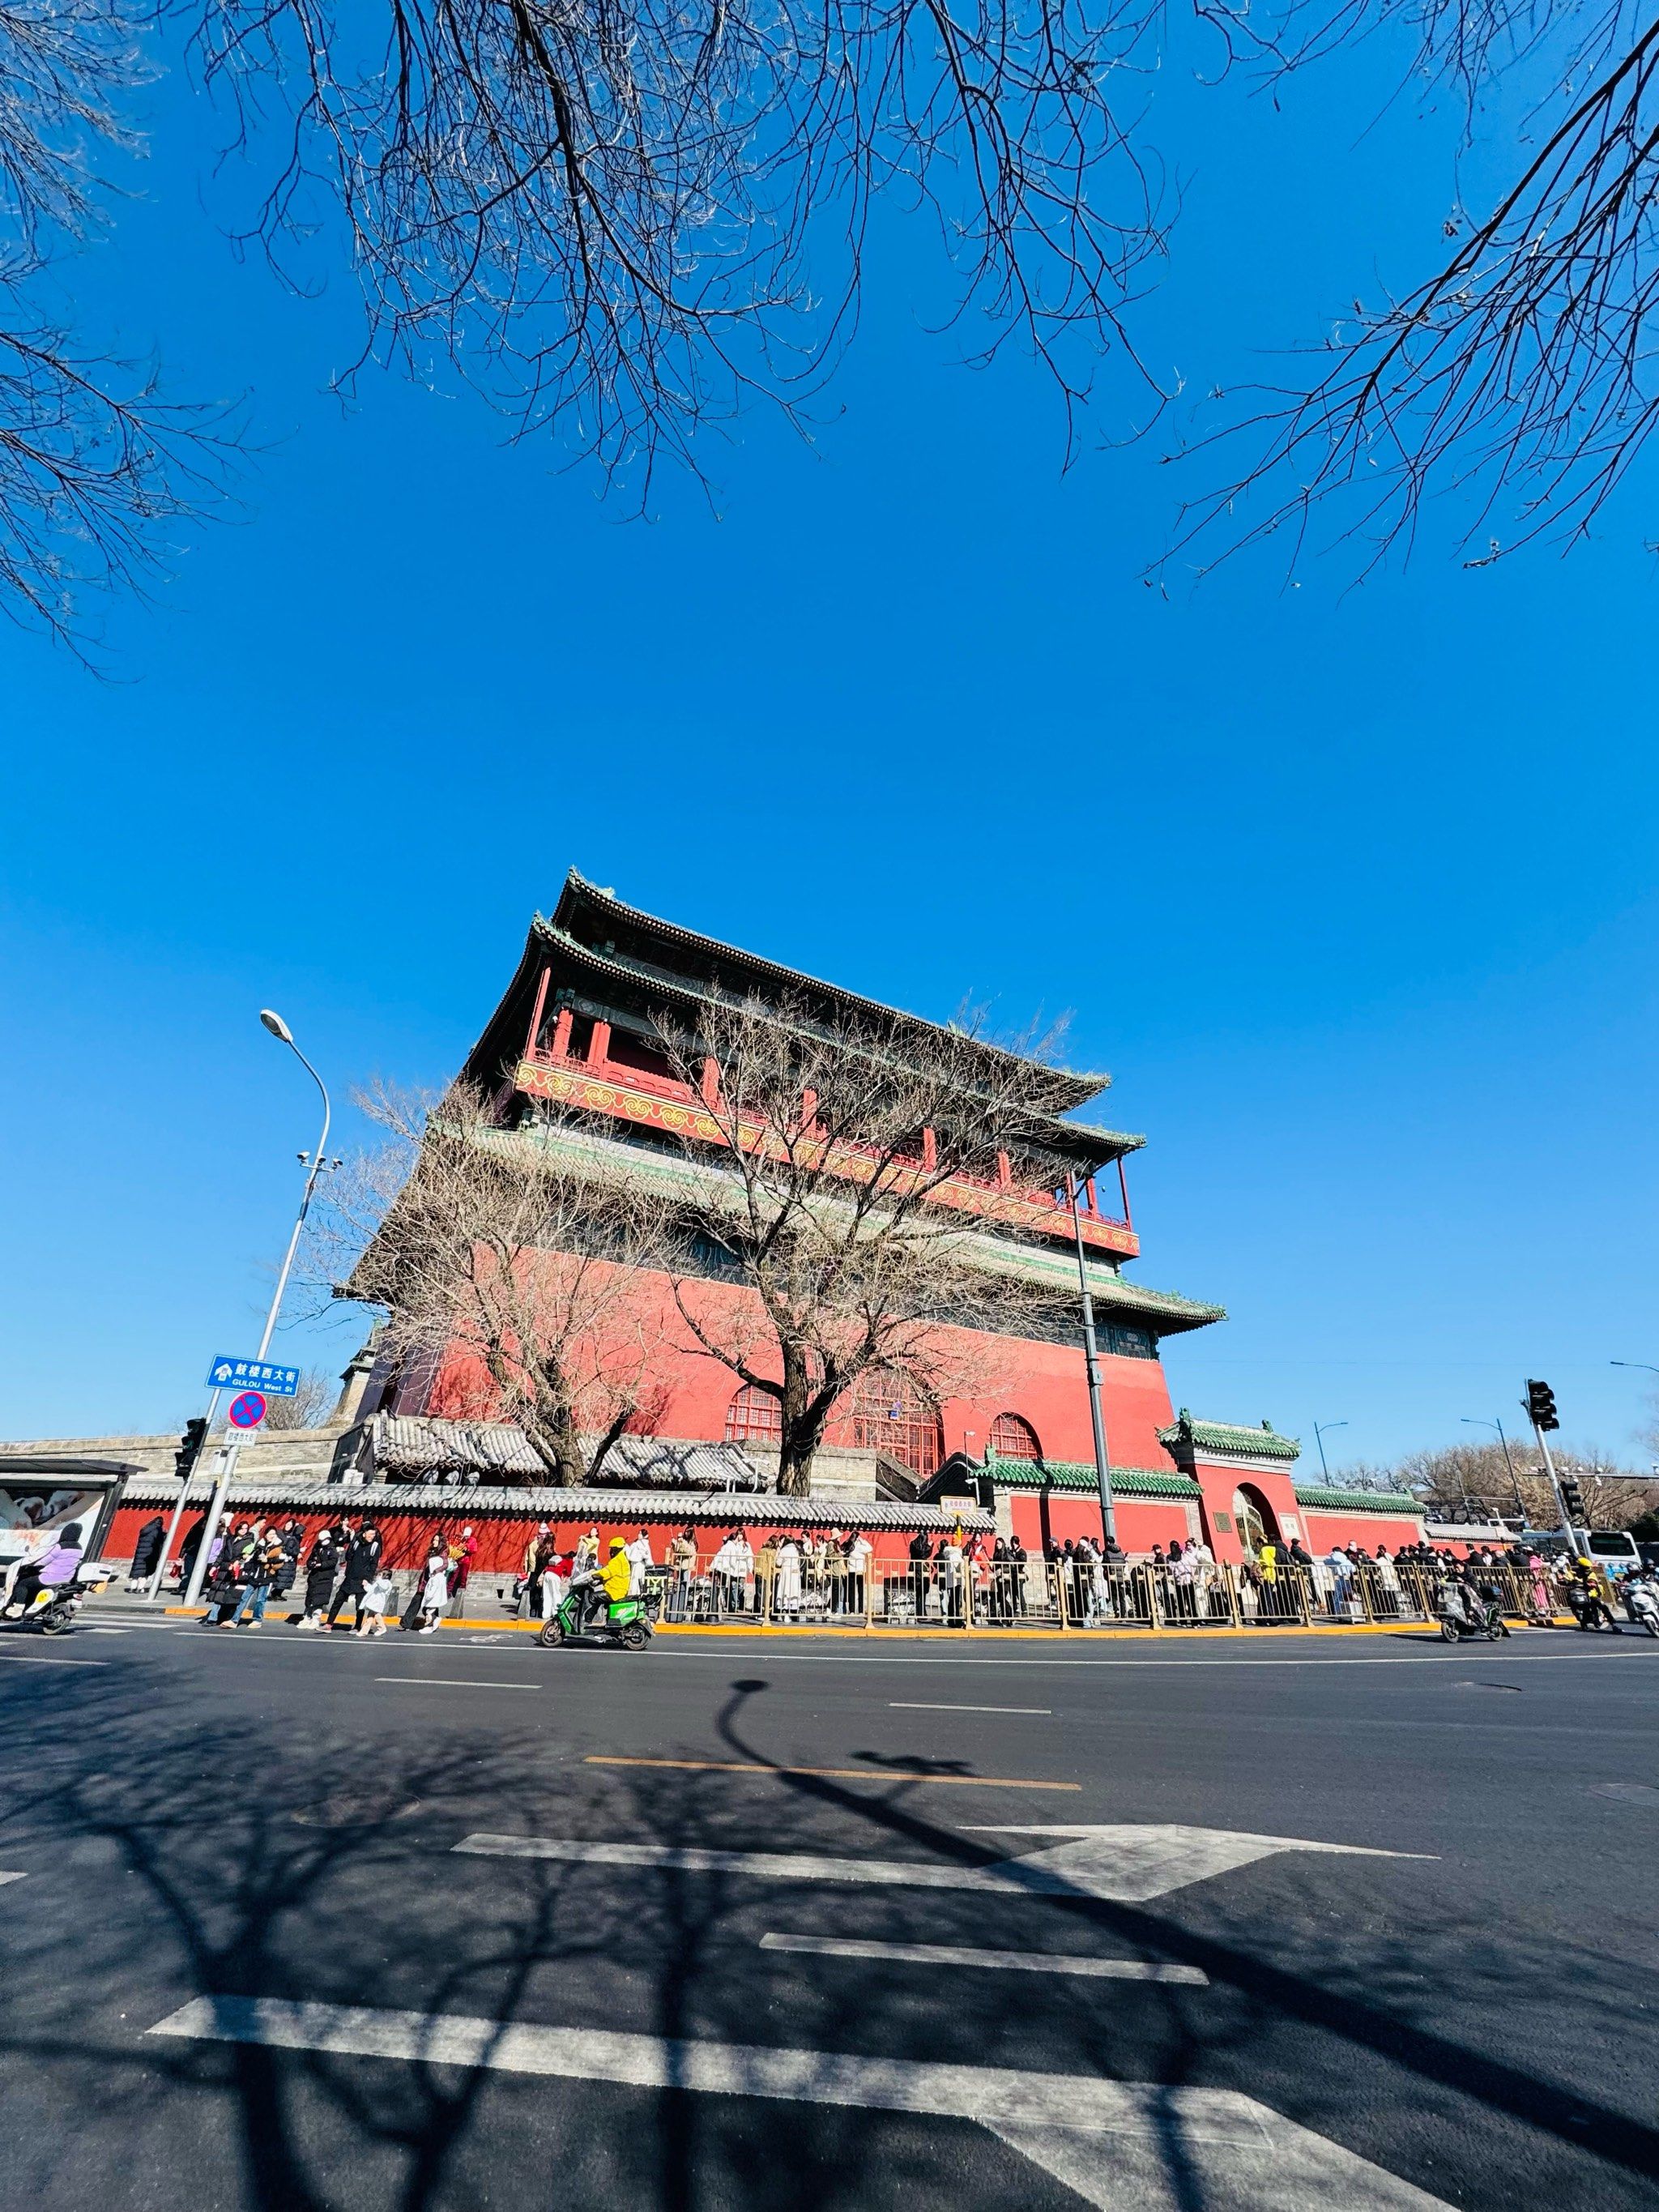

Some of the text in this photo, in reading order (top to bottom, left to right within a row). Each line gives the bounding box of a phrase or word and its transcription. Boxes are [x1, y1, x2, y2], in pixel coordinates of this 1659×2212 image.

[234, 1363, 296, 1383] 鼓楼西大街
[232, 1378, 261, 1388] GULOU
[264, 1383, 282, 1391] West
